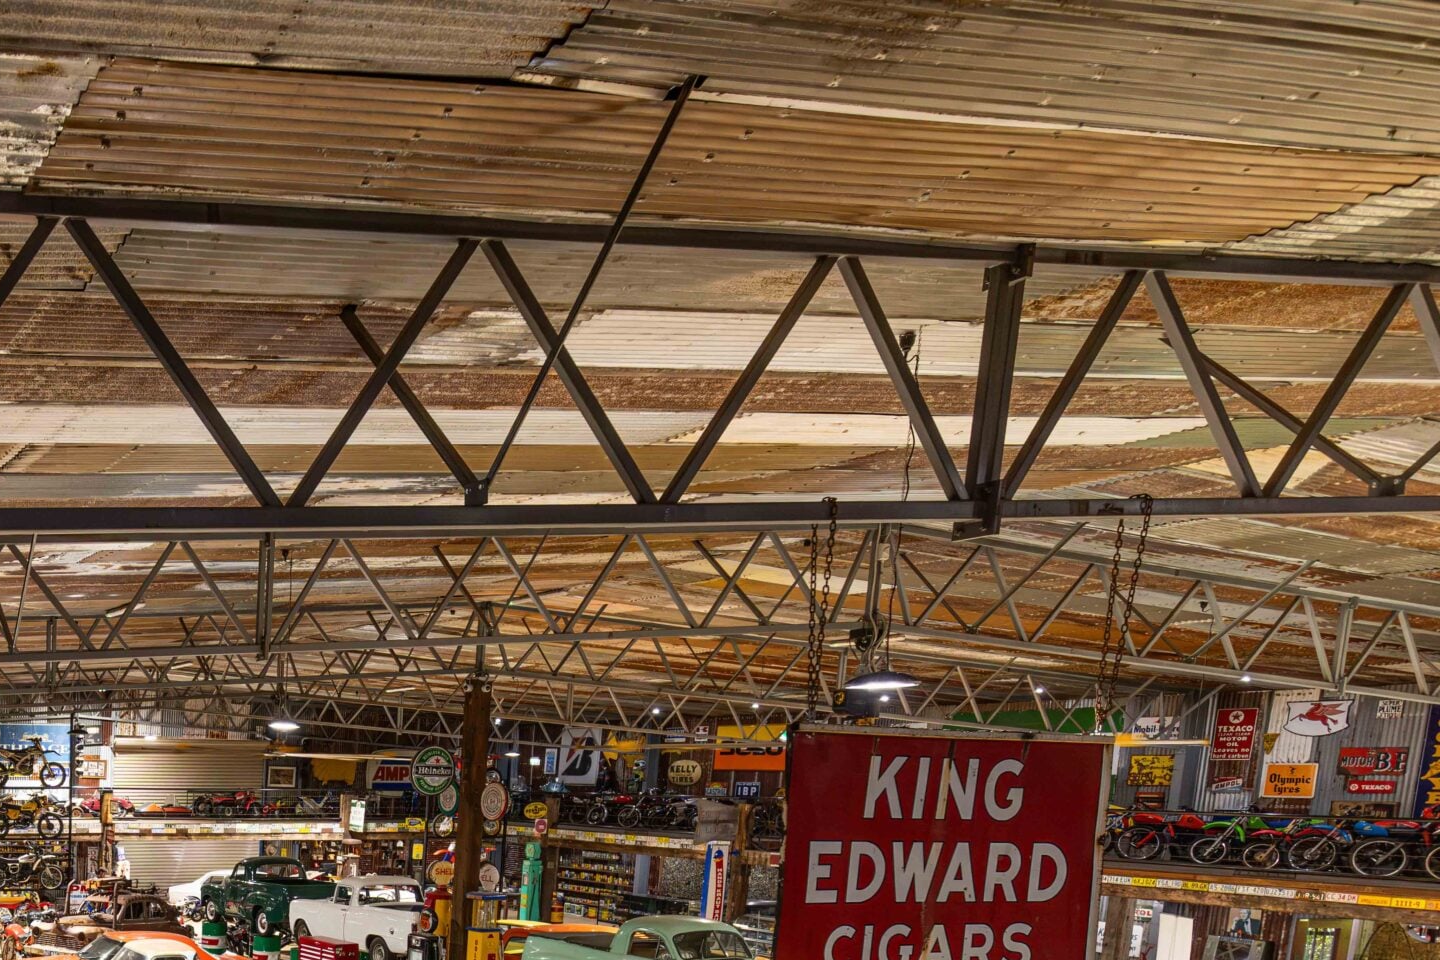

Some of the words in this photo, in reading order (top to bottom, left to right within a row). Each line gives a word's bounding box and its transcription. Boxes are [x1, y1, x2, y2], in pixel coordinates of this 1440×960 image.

[372, 766, 410, 781] AMP
[418, 766, 452, 775] Heineken
[670, 765, 697, 773] KELLY
[1269, 773, 1311, 786] Olympic
[863, 755, 1024, 821] KING
[1273, 784, 1301, 795] tyres
[805, 840, 1068, 903] EDWARD
